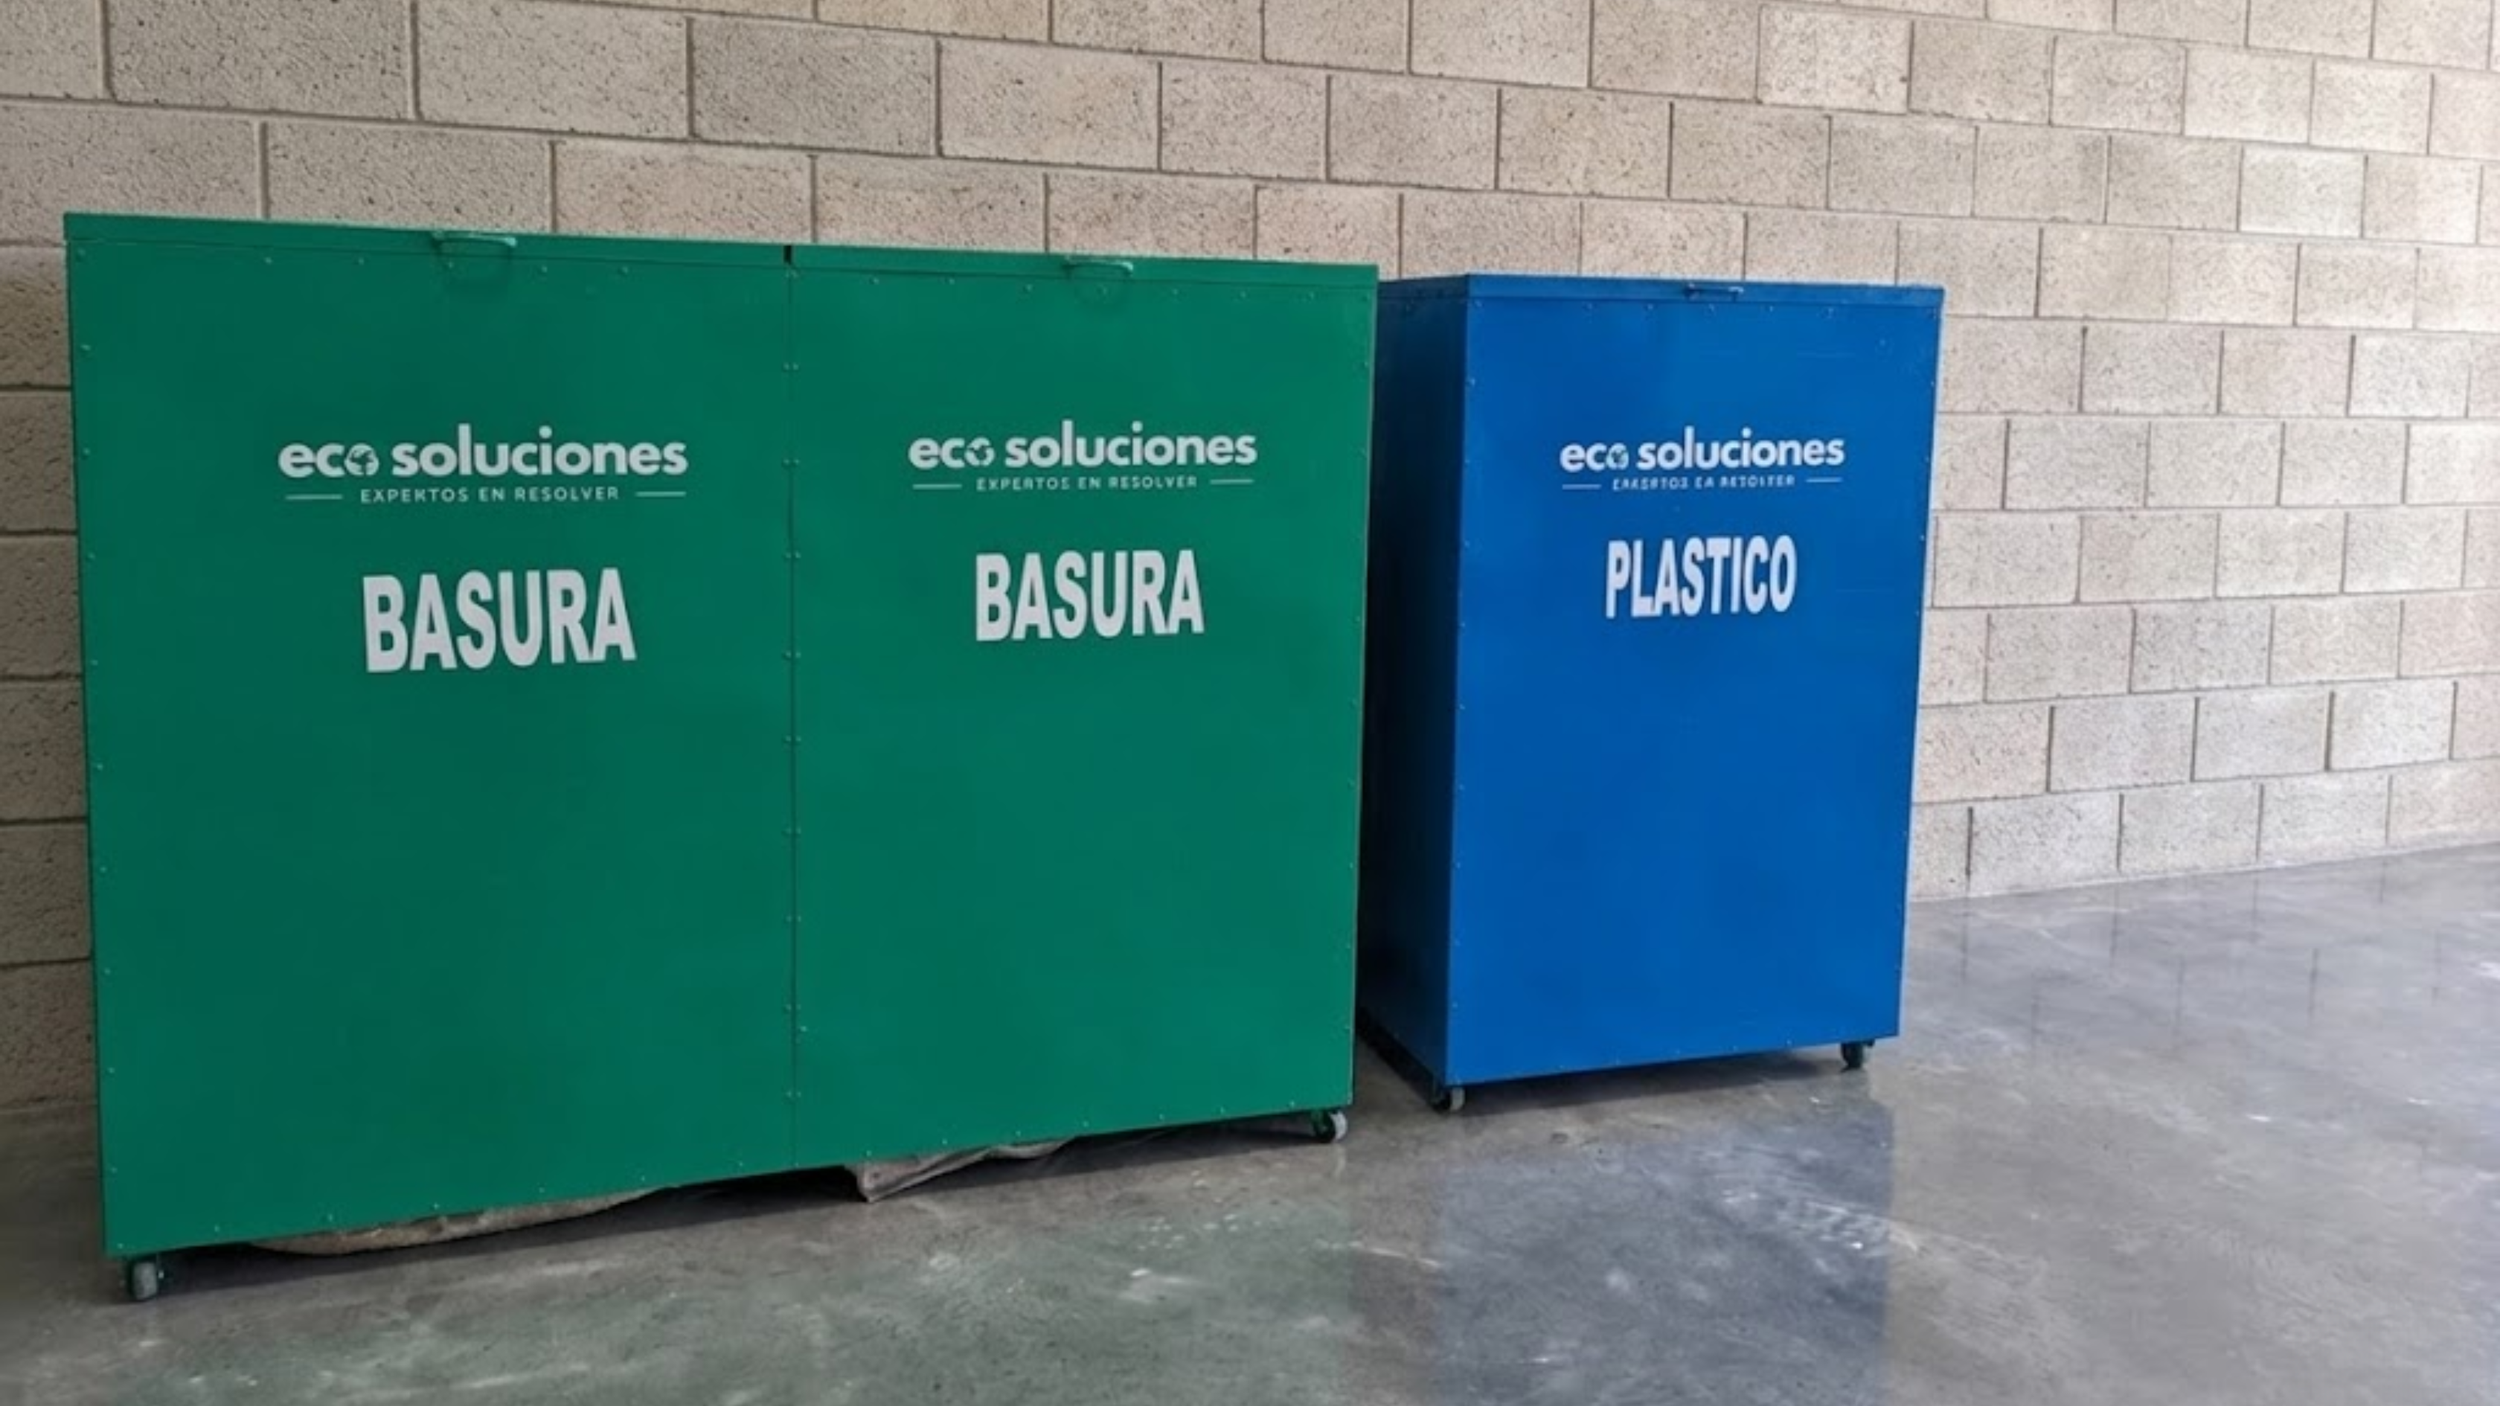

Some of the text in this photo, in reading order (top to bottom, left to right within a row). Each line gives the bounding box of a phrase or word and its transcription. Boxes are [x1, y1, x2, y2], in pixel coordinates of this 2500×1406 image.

[391, 422, 689, 478] soluciones
[1005, 418, 1257, 468] soluciones
[1636, 426, 1845, 471] soluciones
[478, 486, 506, 502] EN
[513, 485, 619, 502] RESOLVER
[1077, 476, 1102, 490] EN
[1107, 474, 1198, 490] RESOLVER
[976, 550, 1205, 642] BASURA
[1605, 534, 1797, 619] PLASTICO
[363, 568, 637, 673] BASURA
